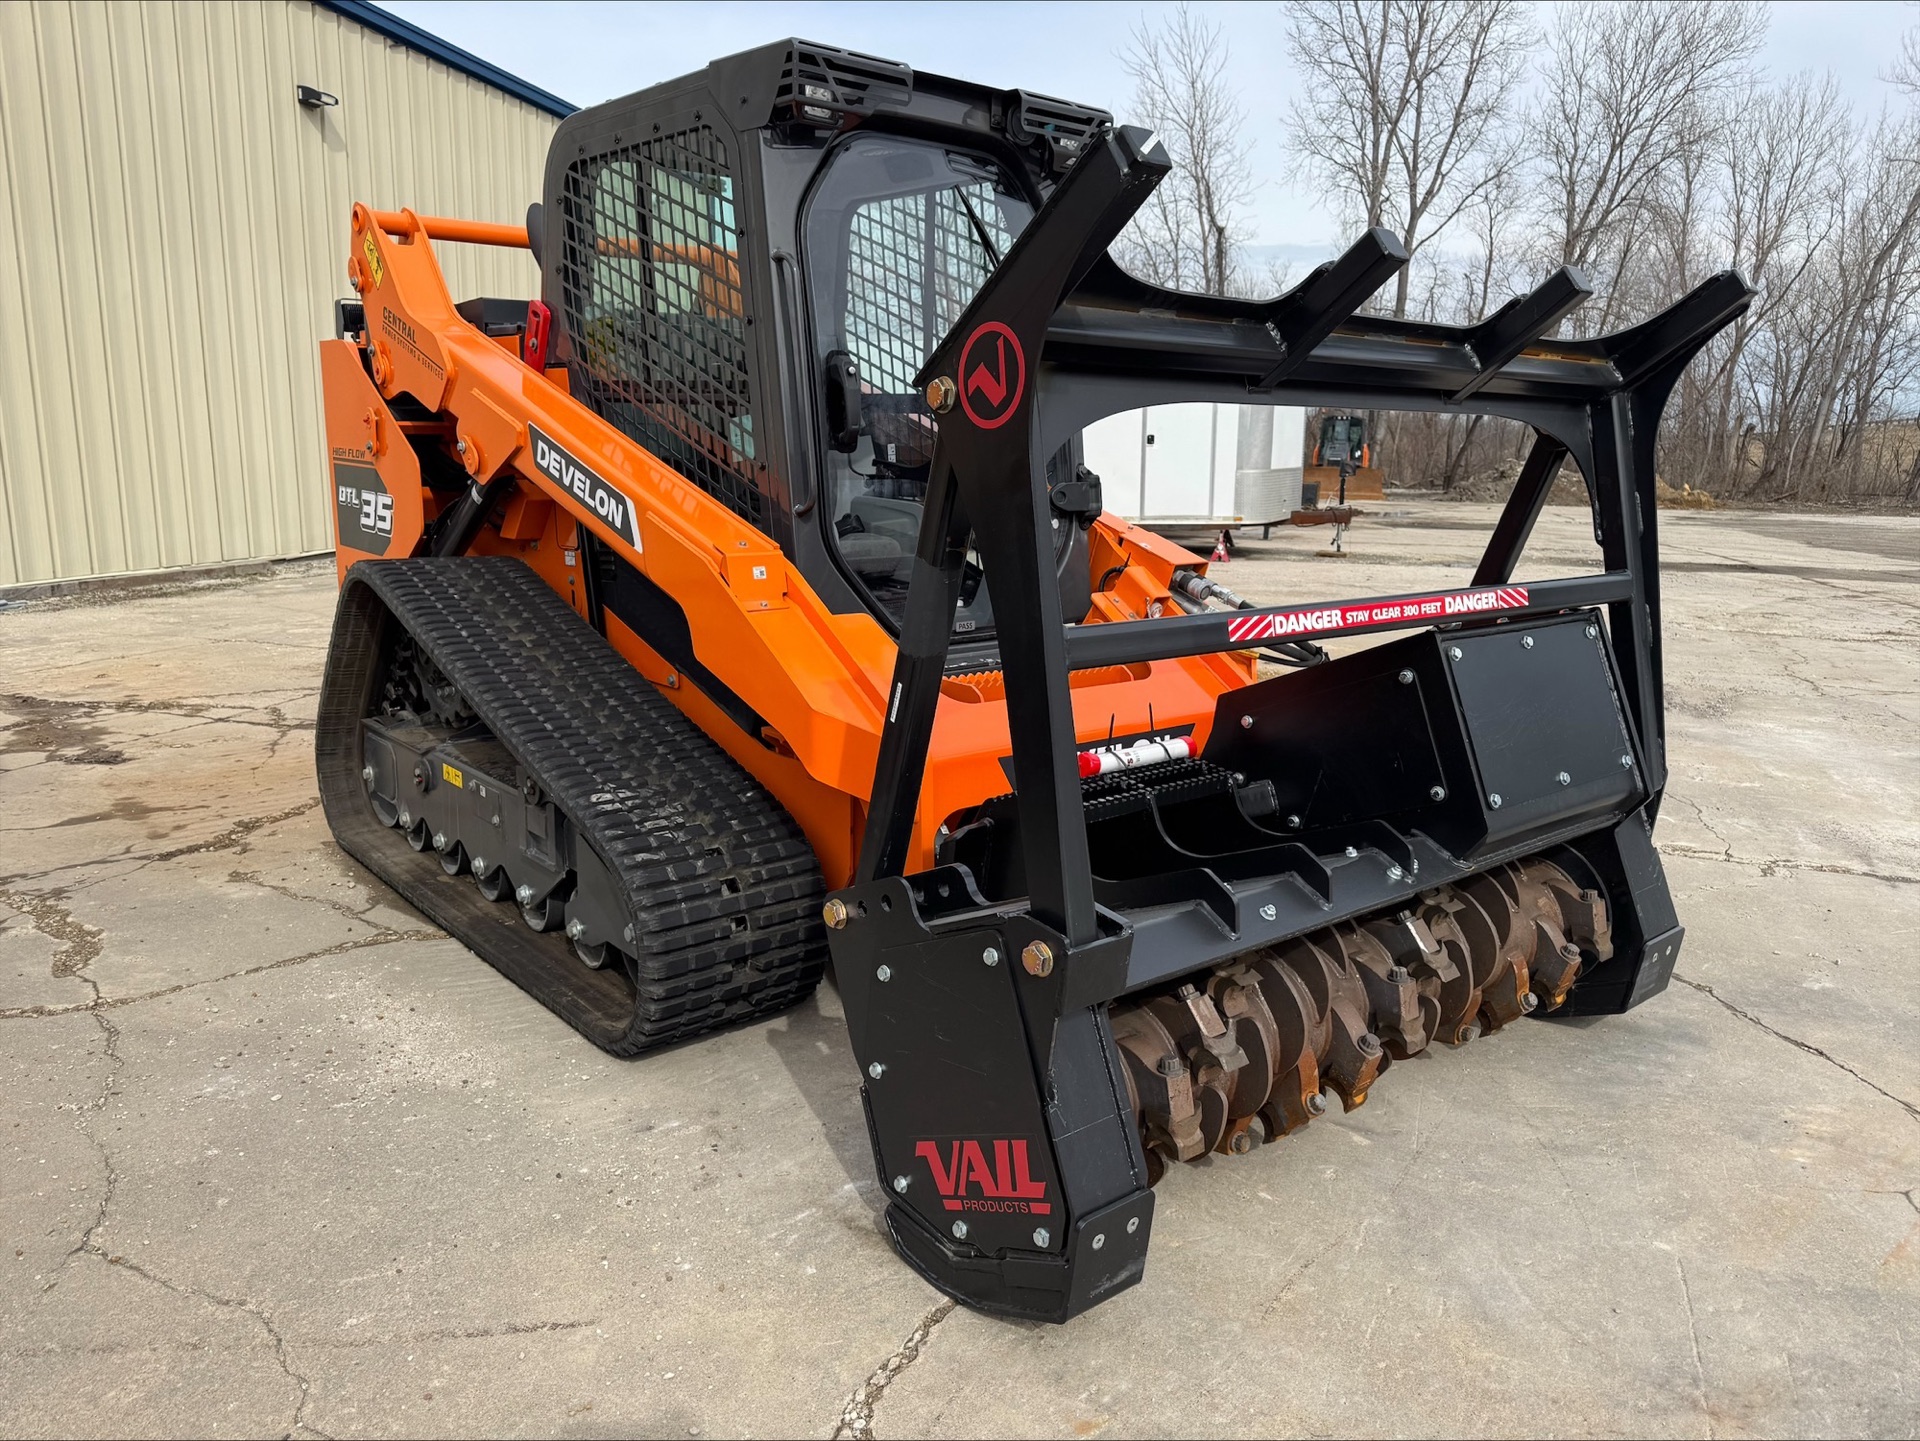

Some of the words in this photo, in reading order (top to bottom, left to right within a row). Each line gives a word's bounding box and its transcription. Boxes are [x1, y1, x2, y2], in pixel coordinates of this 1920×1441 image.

[383, 306, 416, 344] CENTRAL
[382, 324, 396, 341] POWER
[397, 337, 416, 358] SYSTEMS
[422, 357, 443, 381] SERVICES
[333, 447, 346, 456] HIGH
[348, 449, 365, 459] FLOW
[537, 440, 623, 529] DEVELON
[339, 486, 360, 508] DTL
[360, 490, 394, 537] 35
[959, 622, 973, 630] PASS
[1275, 610, 1343, 634] DANGER
[1346, 609, 1370, 624] STAY
[1372, 606, 1401, 619] CLEAR
[1402, 604, 1419, 617] 300
[1421, 602, 1441, 615] FEET
[1445, 592, 1498, 613] DANGER
[915, 1140, 1046, 1198] VAIL
[963, 1200, 1029, 1213] PRODUCTS
